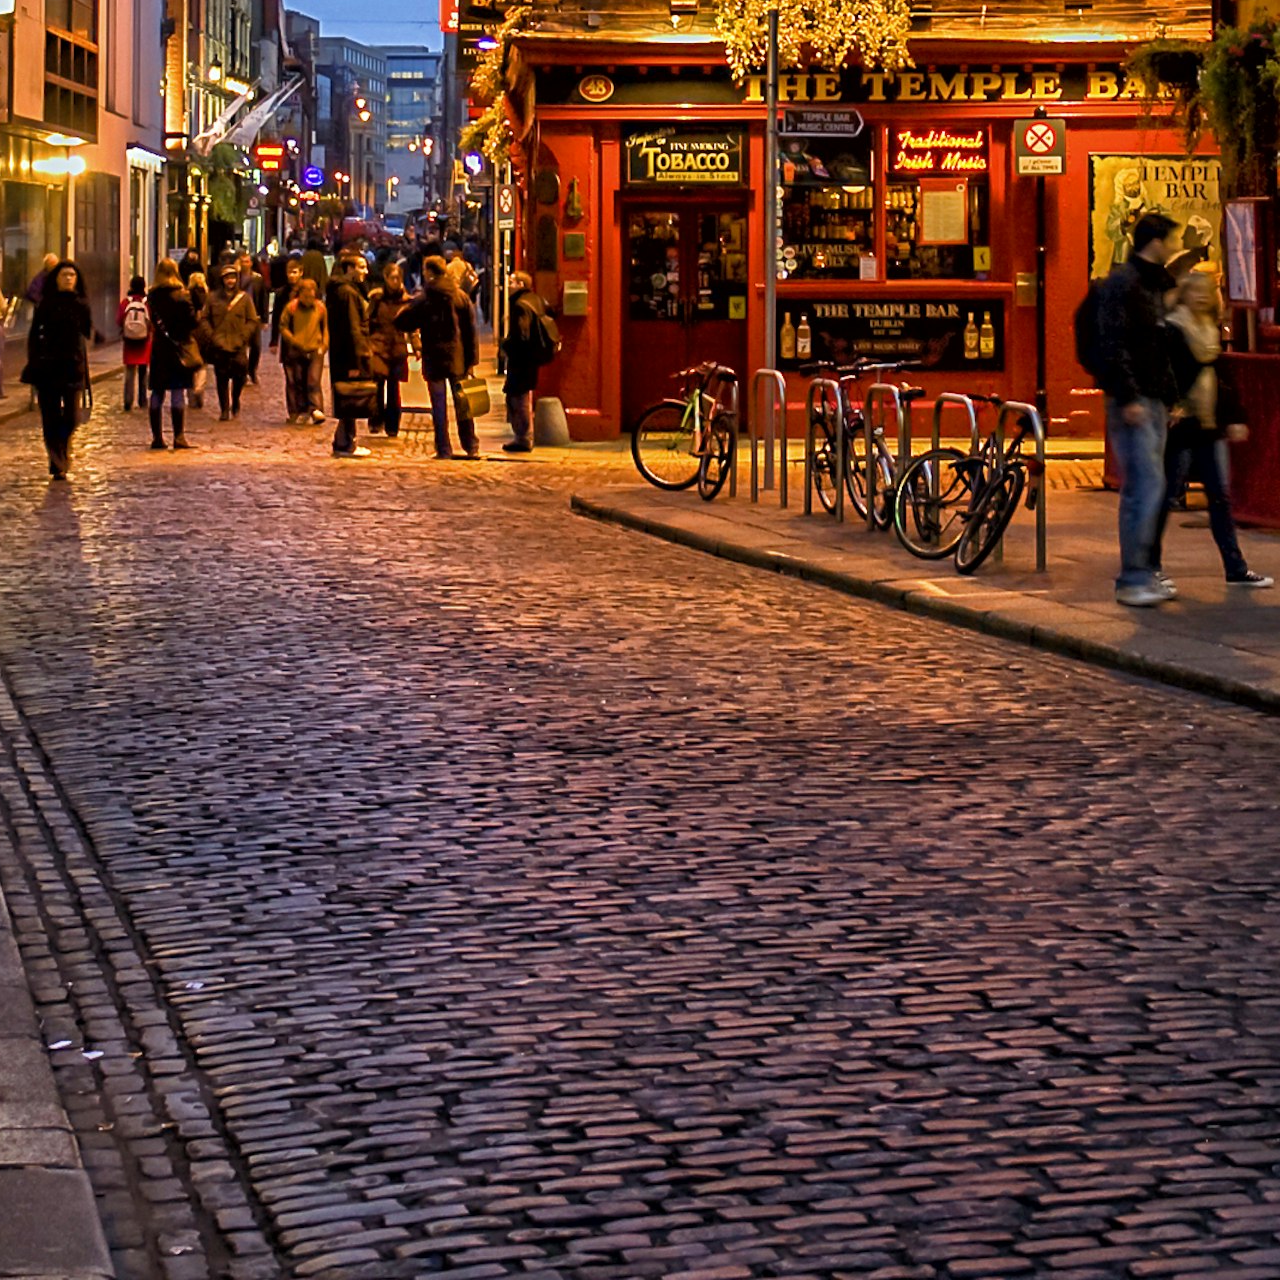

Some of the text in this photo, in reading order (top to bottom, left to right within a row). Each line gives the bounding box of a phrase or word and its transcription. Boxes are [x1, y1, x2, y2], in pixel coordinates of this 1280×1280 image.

[585, 80, 607, 95] 48
[743, 72, 843, 101] THE
[861, 71, 1064, 101] TEMPLE
[802, 112, 850, 122] TEMPLE BAR
[797, 123, 855, 132] MUSIC CENTRE
[897, 130, 984, 149] Traditional
[642, 147, 730, 178] TOBACCO
[893, 151, 987, 171] Irish Music
[658, 173, 692, 181] Always
[709, 172, 737, 180] Stock
[1166, 182, 1208, 200] BAR
[795, 244, 863, 255] LIVE MUSIC
[813, 303, 961, 318] THE TEMPLE BAR
[869, 319, 905, 328] DUBLIN
[873, 342, 896, 351] MUSIC
